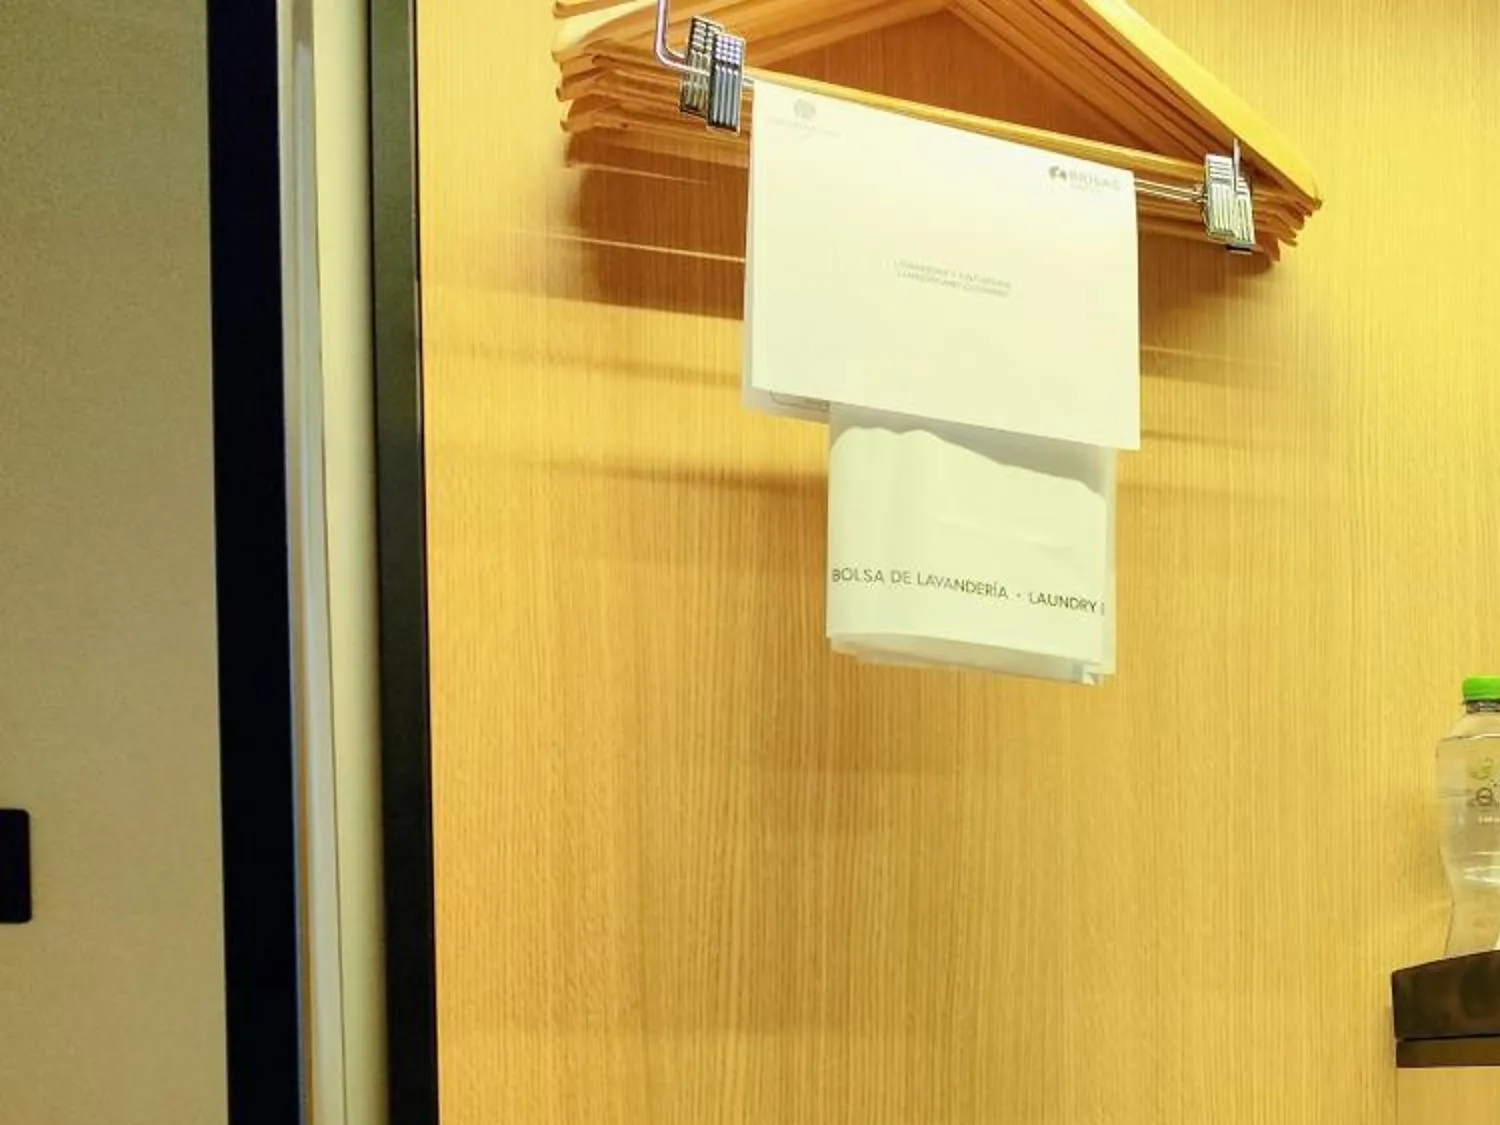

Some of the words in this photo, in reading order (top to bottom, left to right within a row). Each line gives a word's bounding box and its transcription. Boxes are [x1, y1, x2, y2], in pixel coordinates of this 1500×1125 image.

[832, 567, 884, 584] BOLSA
[890, 569, 912, 585] DE
[1028, 591, 1097, 614] LAUNDRY
